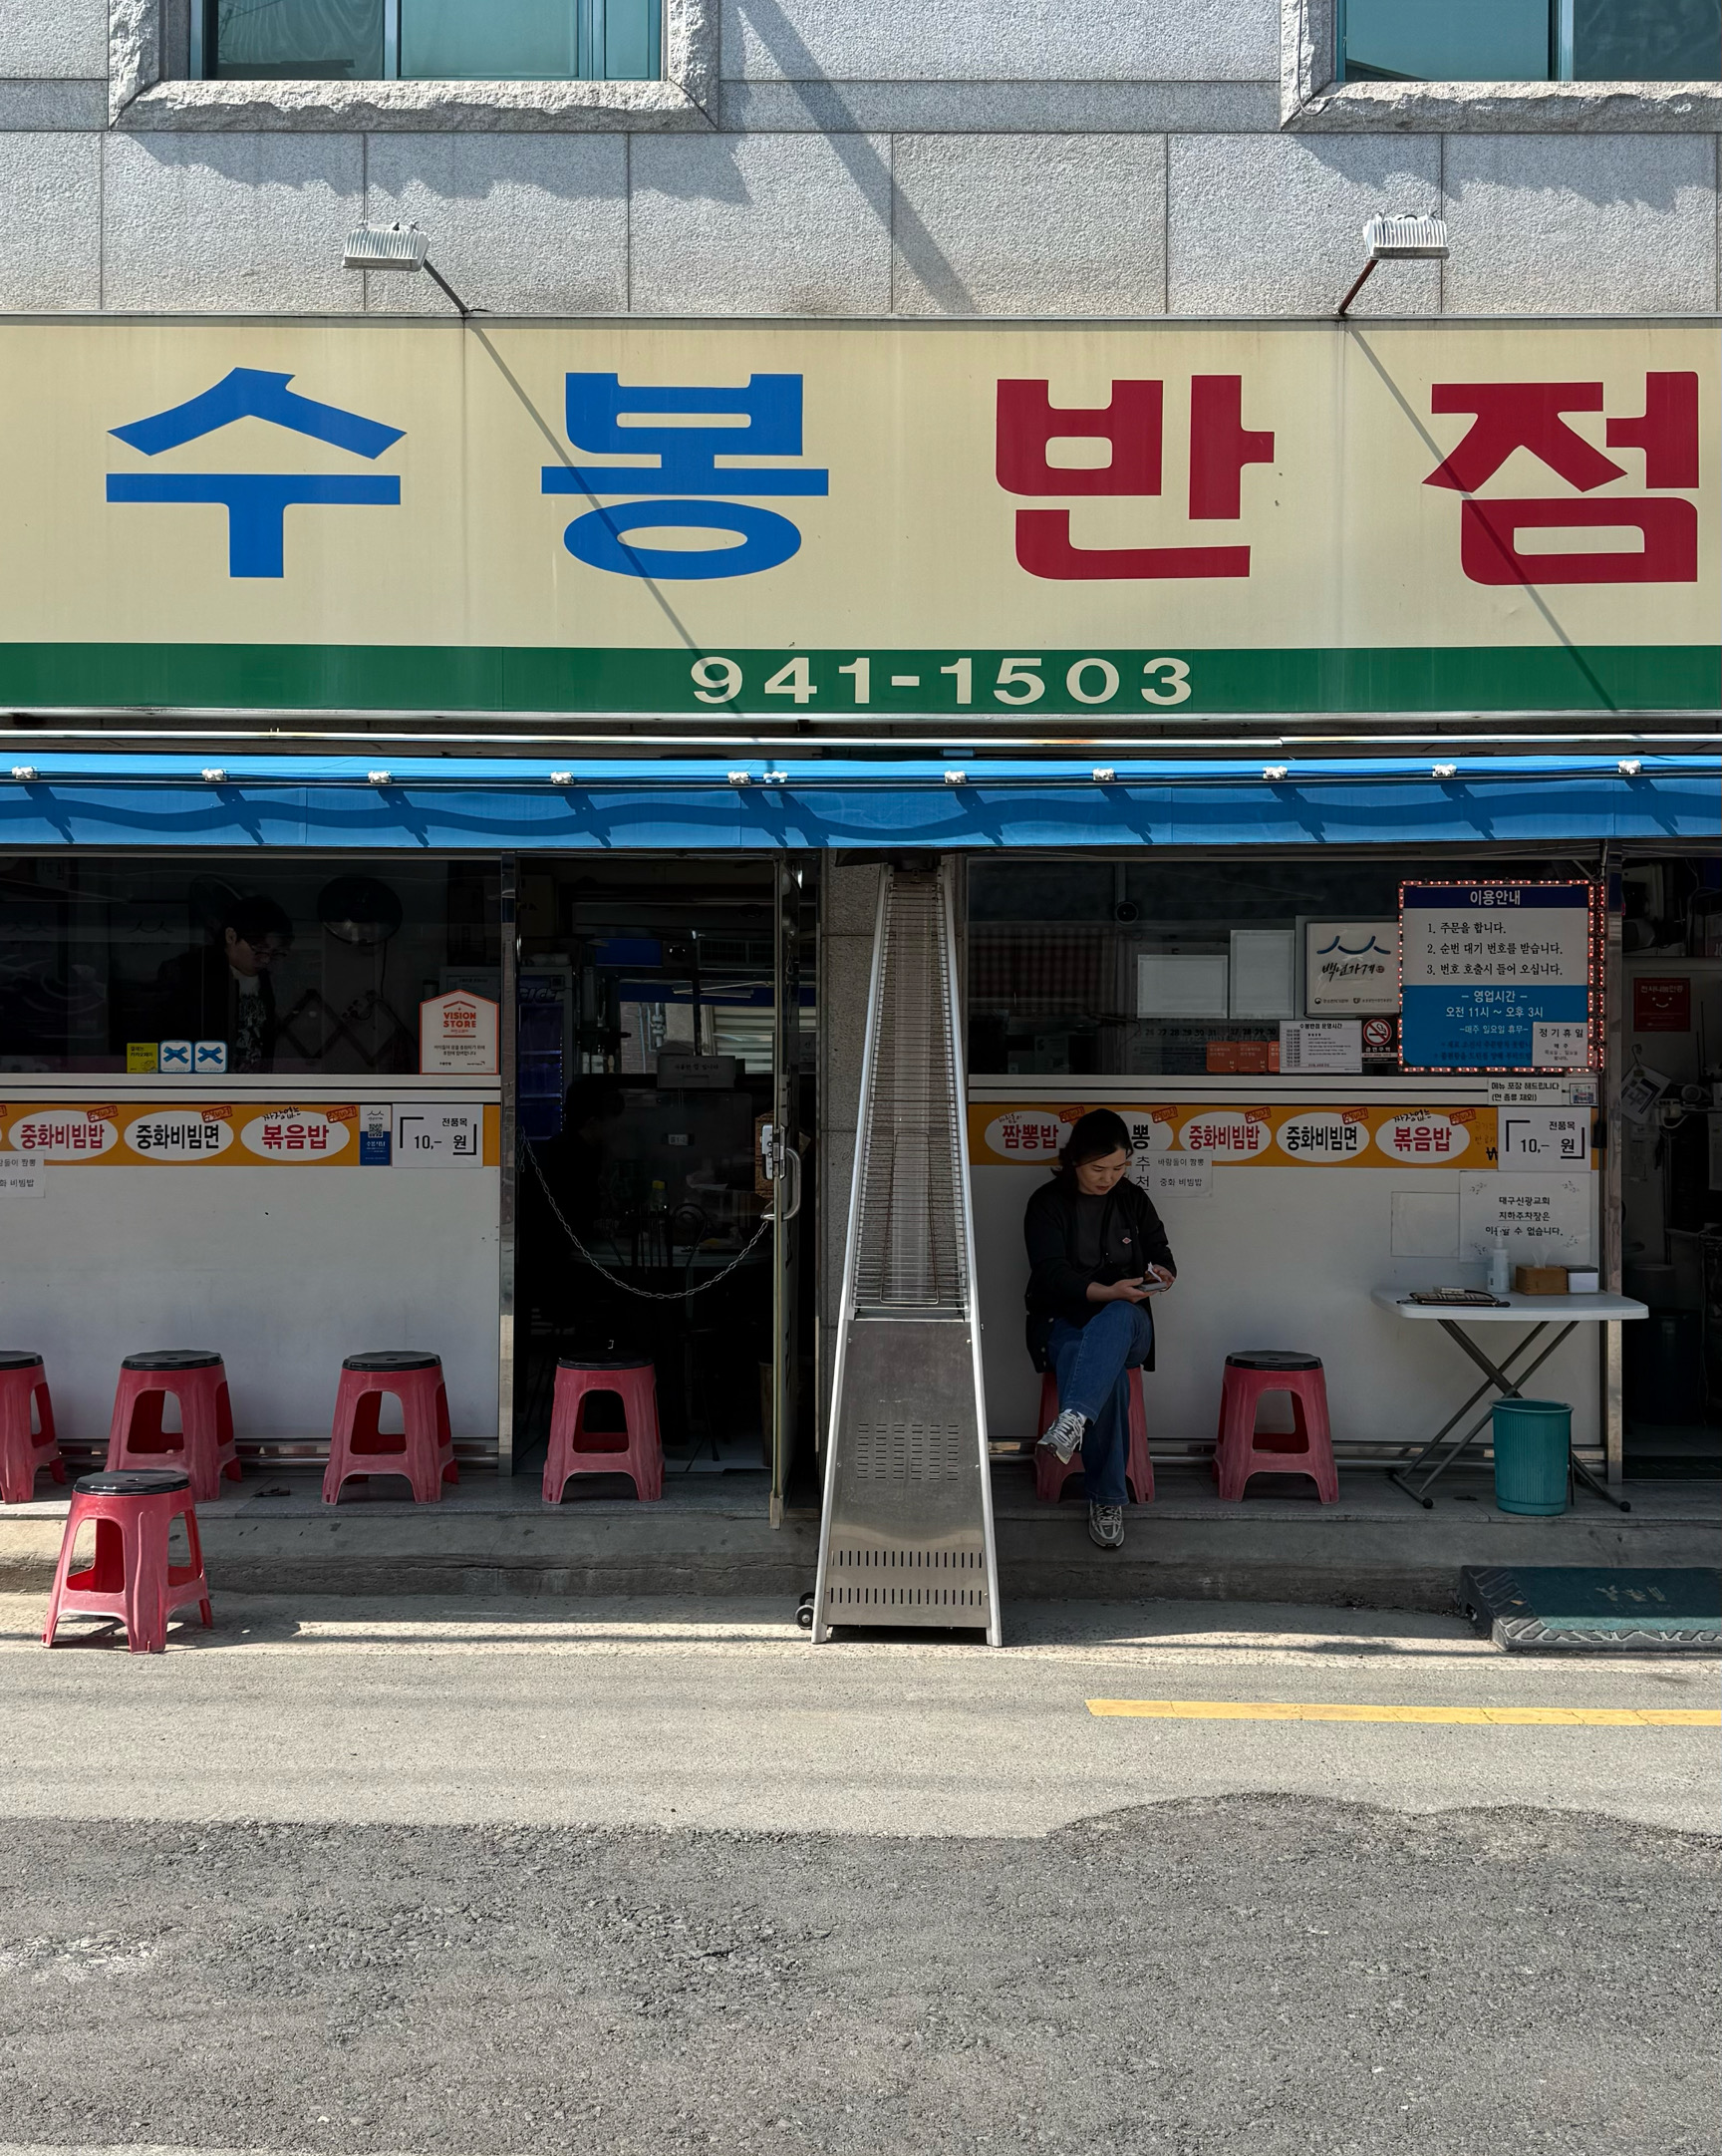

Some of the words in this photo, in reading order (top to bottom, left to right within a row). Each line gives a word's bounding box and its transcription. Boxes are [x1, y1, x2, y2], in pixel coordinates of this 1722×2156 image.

[107, 367, 1700, 586] 수봉반점
[690, 655, 1193, 707] 941-1503
[1470, 890, 1521, 906] 이용안내
[1440, 922, 1469, 934] 주문을
[1474, 922, 1507, 934] 합니다.
[1440, 943, 1460, 955] 순번
[1464, 943, 1483, 955] 대기
[1487, 943, 1517, 955] 번호를
[1520, 943, 1563, 955] 받습니다.
[1322, 962, 1375, 983] 백년가게
[1440, 963, 1460, 976] 번호
[1464, 963, 1493, 976] 호출시
[1497, 963, 1516, 976] 들어
[1520, 963, 1563, 976] 오십니다.
[1474, 990, 1516, 1003] 영업시간
[1446, 1007, 1464, 1018] 오전
[1469, 1007, 1490, 1018] 11시
[1506, 1007, 1524, 1018] 오후
[1528, 1007, 1544, 1018] 3시
[1170, 1028, 1180, 1037] 28
[1182, 1028, 1193, 1037] 29
[1194, 1028, 1205, 1037] 30
[1207, 1028, 1217, 1037] 31
[1242, 1027, 1252, 1036] 28
[1483, 1025, 1505, 1035] 일요일
[441, 1117, 467, 1127] 전품목
[1549, 1120, 1576, 1130] 전품목
[20, 1124, 105, 1149] 중화비빔밥
[136, 1124, 219, 1149] 중화비빔면
[261, 1124, 330, 1150] 볶음밥
[452, 1134, 466, 1150] 원
[1002, 1124, 1058, 1149] 짬뽕밥
[1131, 1124, 1150, 1149] 뽕
[1189, 1124, 1260, 1150] 중화비빔밥
[1286, 1125, 1357, 1151] 중화비빔면
[1393, 1126, 1453, 1152] 볶음밥
[1561, 1138, 1575, 1154] 원
[21, 1158, 36, 1167] 짬뽕
[1158, 1158, 1188, 1167] 바람돌이
[1190, 1158, 1205, 1167] 짬뽕
[10, 1178, 34, 1187] 비빔밥
[1160, 1178, 1176, 1187] 중화
[1178, 1178, 1202, 1187] 비빔밥
[1499, 1196, 1551, 1206] 대구신광교회
[1499, 1211, 1551, 1222] 지하주차장은
[1514, 1226, 1523, 1235] 수
[1527, 1226, 1564, 1236] 없습니다.
